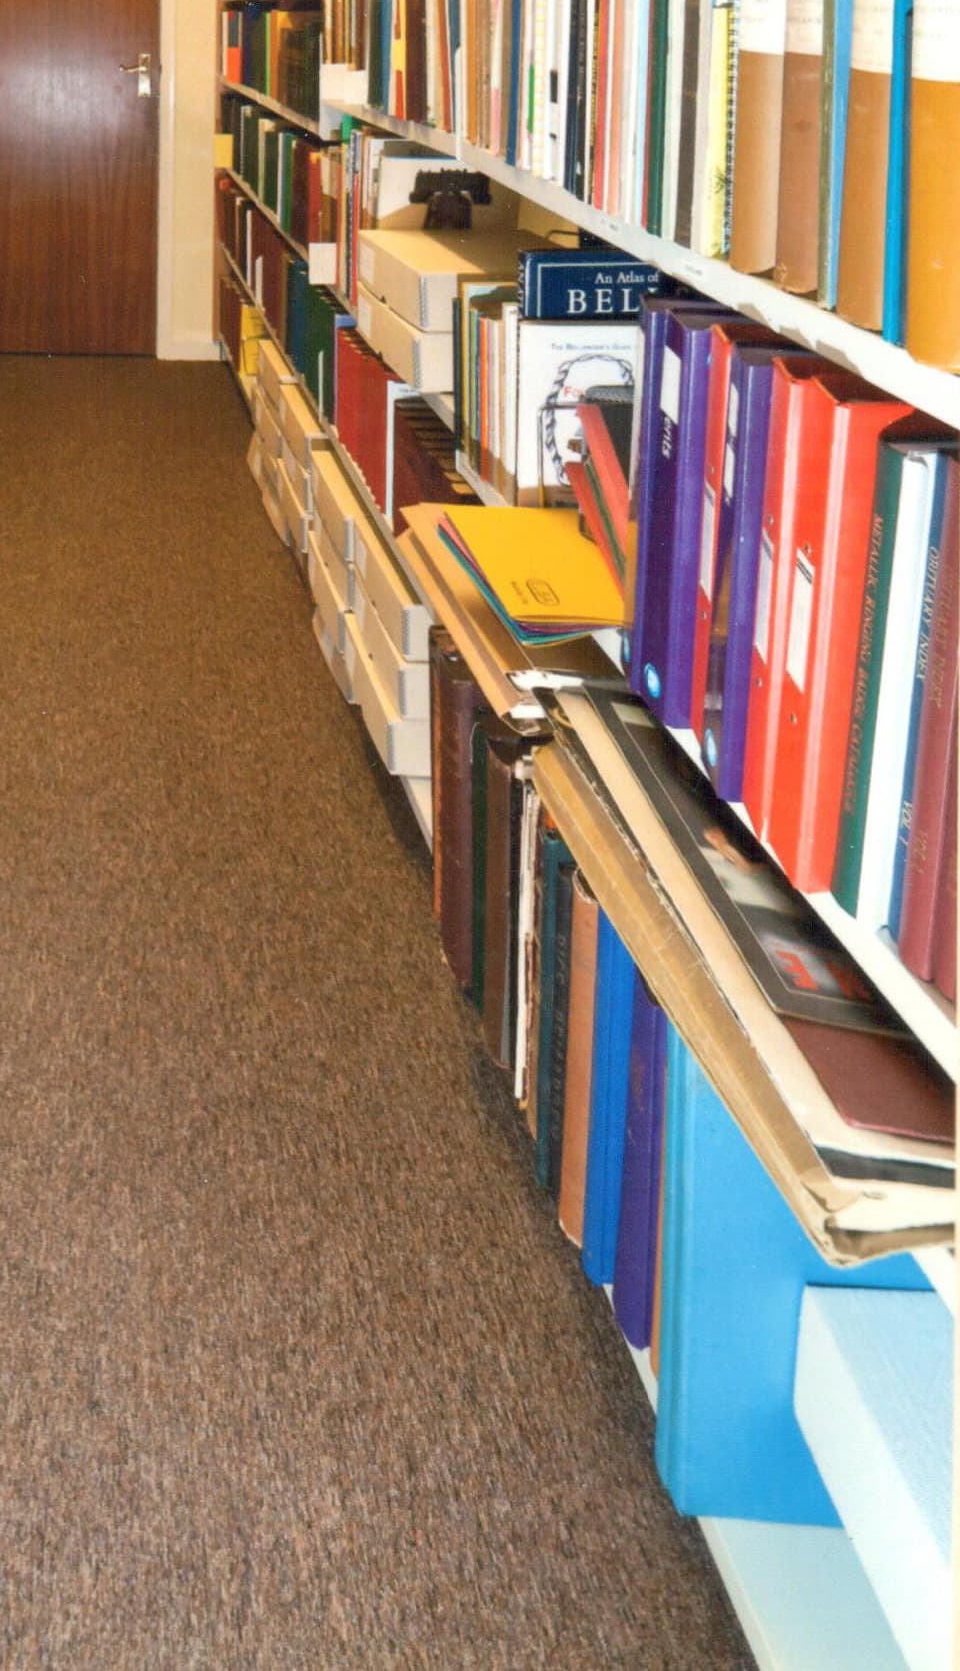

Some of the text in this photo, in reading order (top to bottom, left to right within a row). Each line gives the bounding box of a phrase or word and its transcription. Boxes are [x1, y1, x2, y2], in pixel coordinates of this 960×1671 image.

[595, 270, 659, 284] An Atlas of
[567, 287, 658, 314] BEL
[921, 546, 940, 628] OBITUARY
[917, 632, 931, 680] INDEX
